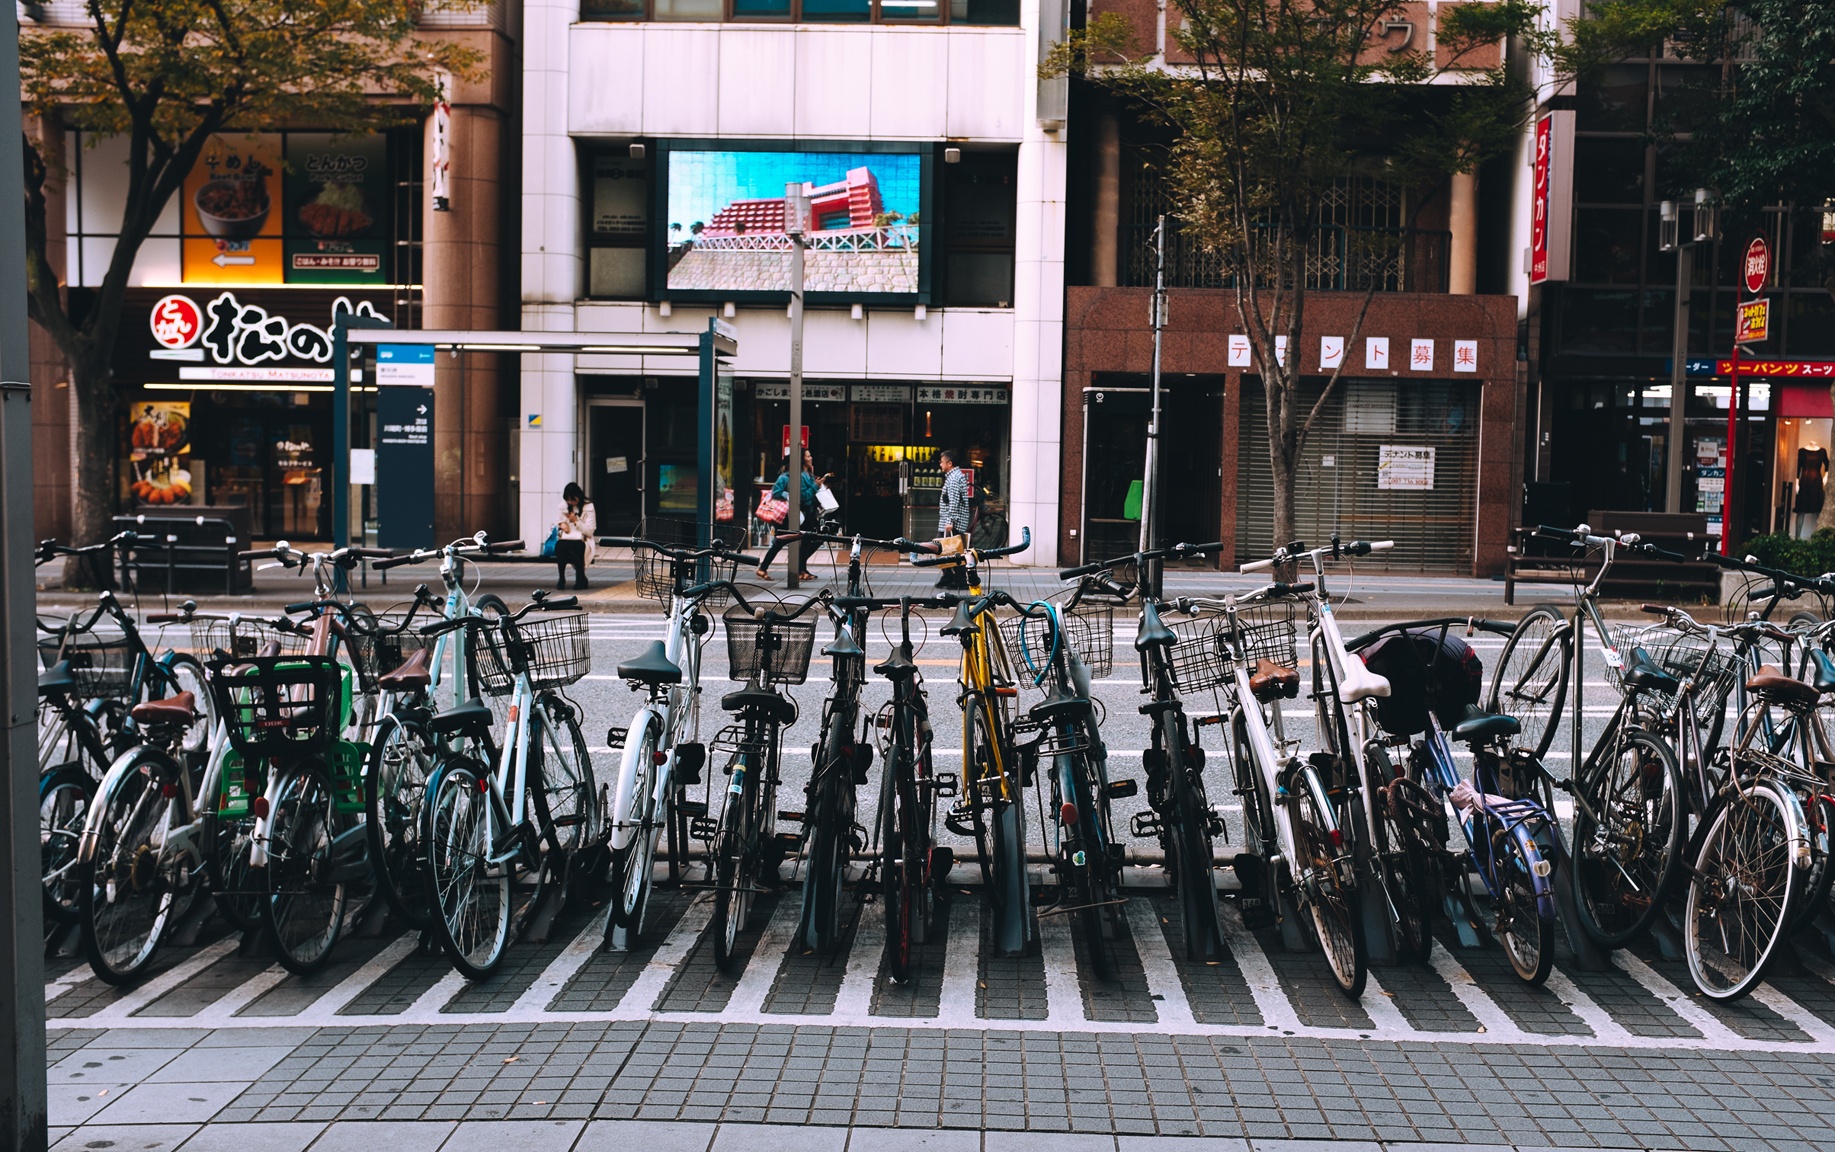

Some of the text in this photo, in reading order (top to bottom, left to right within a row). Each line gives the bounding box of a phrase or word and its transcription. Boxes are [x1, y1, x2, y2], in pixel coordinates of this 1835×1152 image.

[305, 154, 367, 172] とんかつ
[1535, 129, 1548, 252] ダンカン
[1747, 253, 1765, 277] 消火栓
[1802, 364, 1833, 375] スーツ
[919, 388, 1006, 401] 本格焼酎専門店
[1384, 451, 1431, 460] テナント募集
